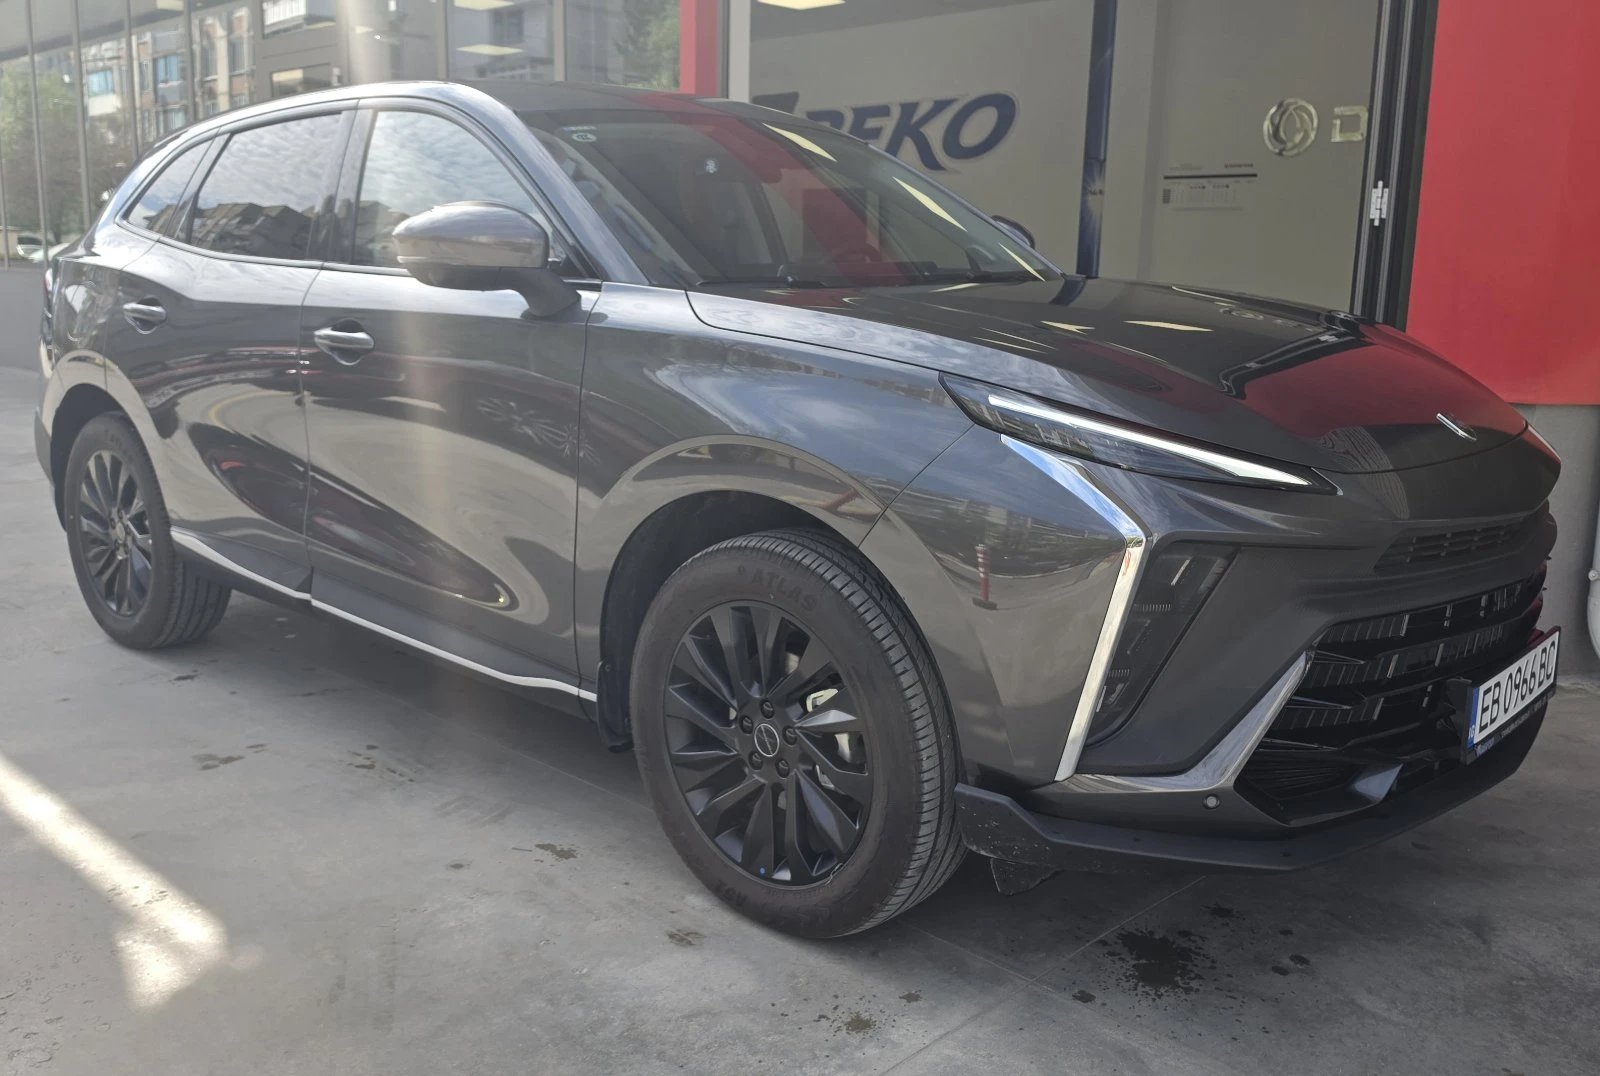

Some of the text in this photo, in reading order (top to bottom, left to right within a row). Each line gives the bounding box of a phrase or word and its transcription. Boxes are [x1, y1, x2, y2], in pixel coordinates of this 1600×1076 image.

[1478, 680, 1502, 734] EB
[1503, 653, 1537, 715] 0966
[1537, 640, 1556, 688] BC
